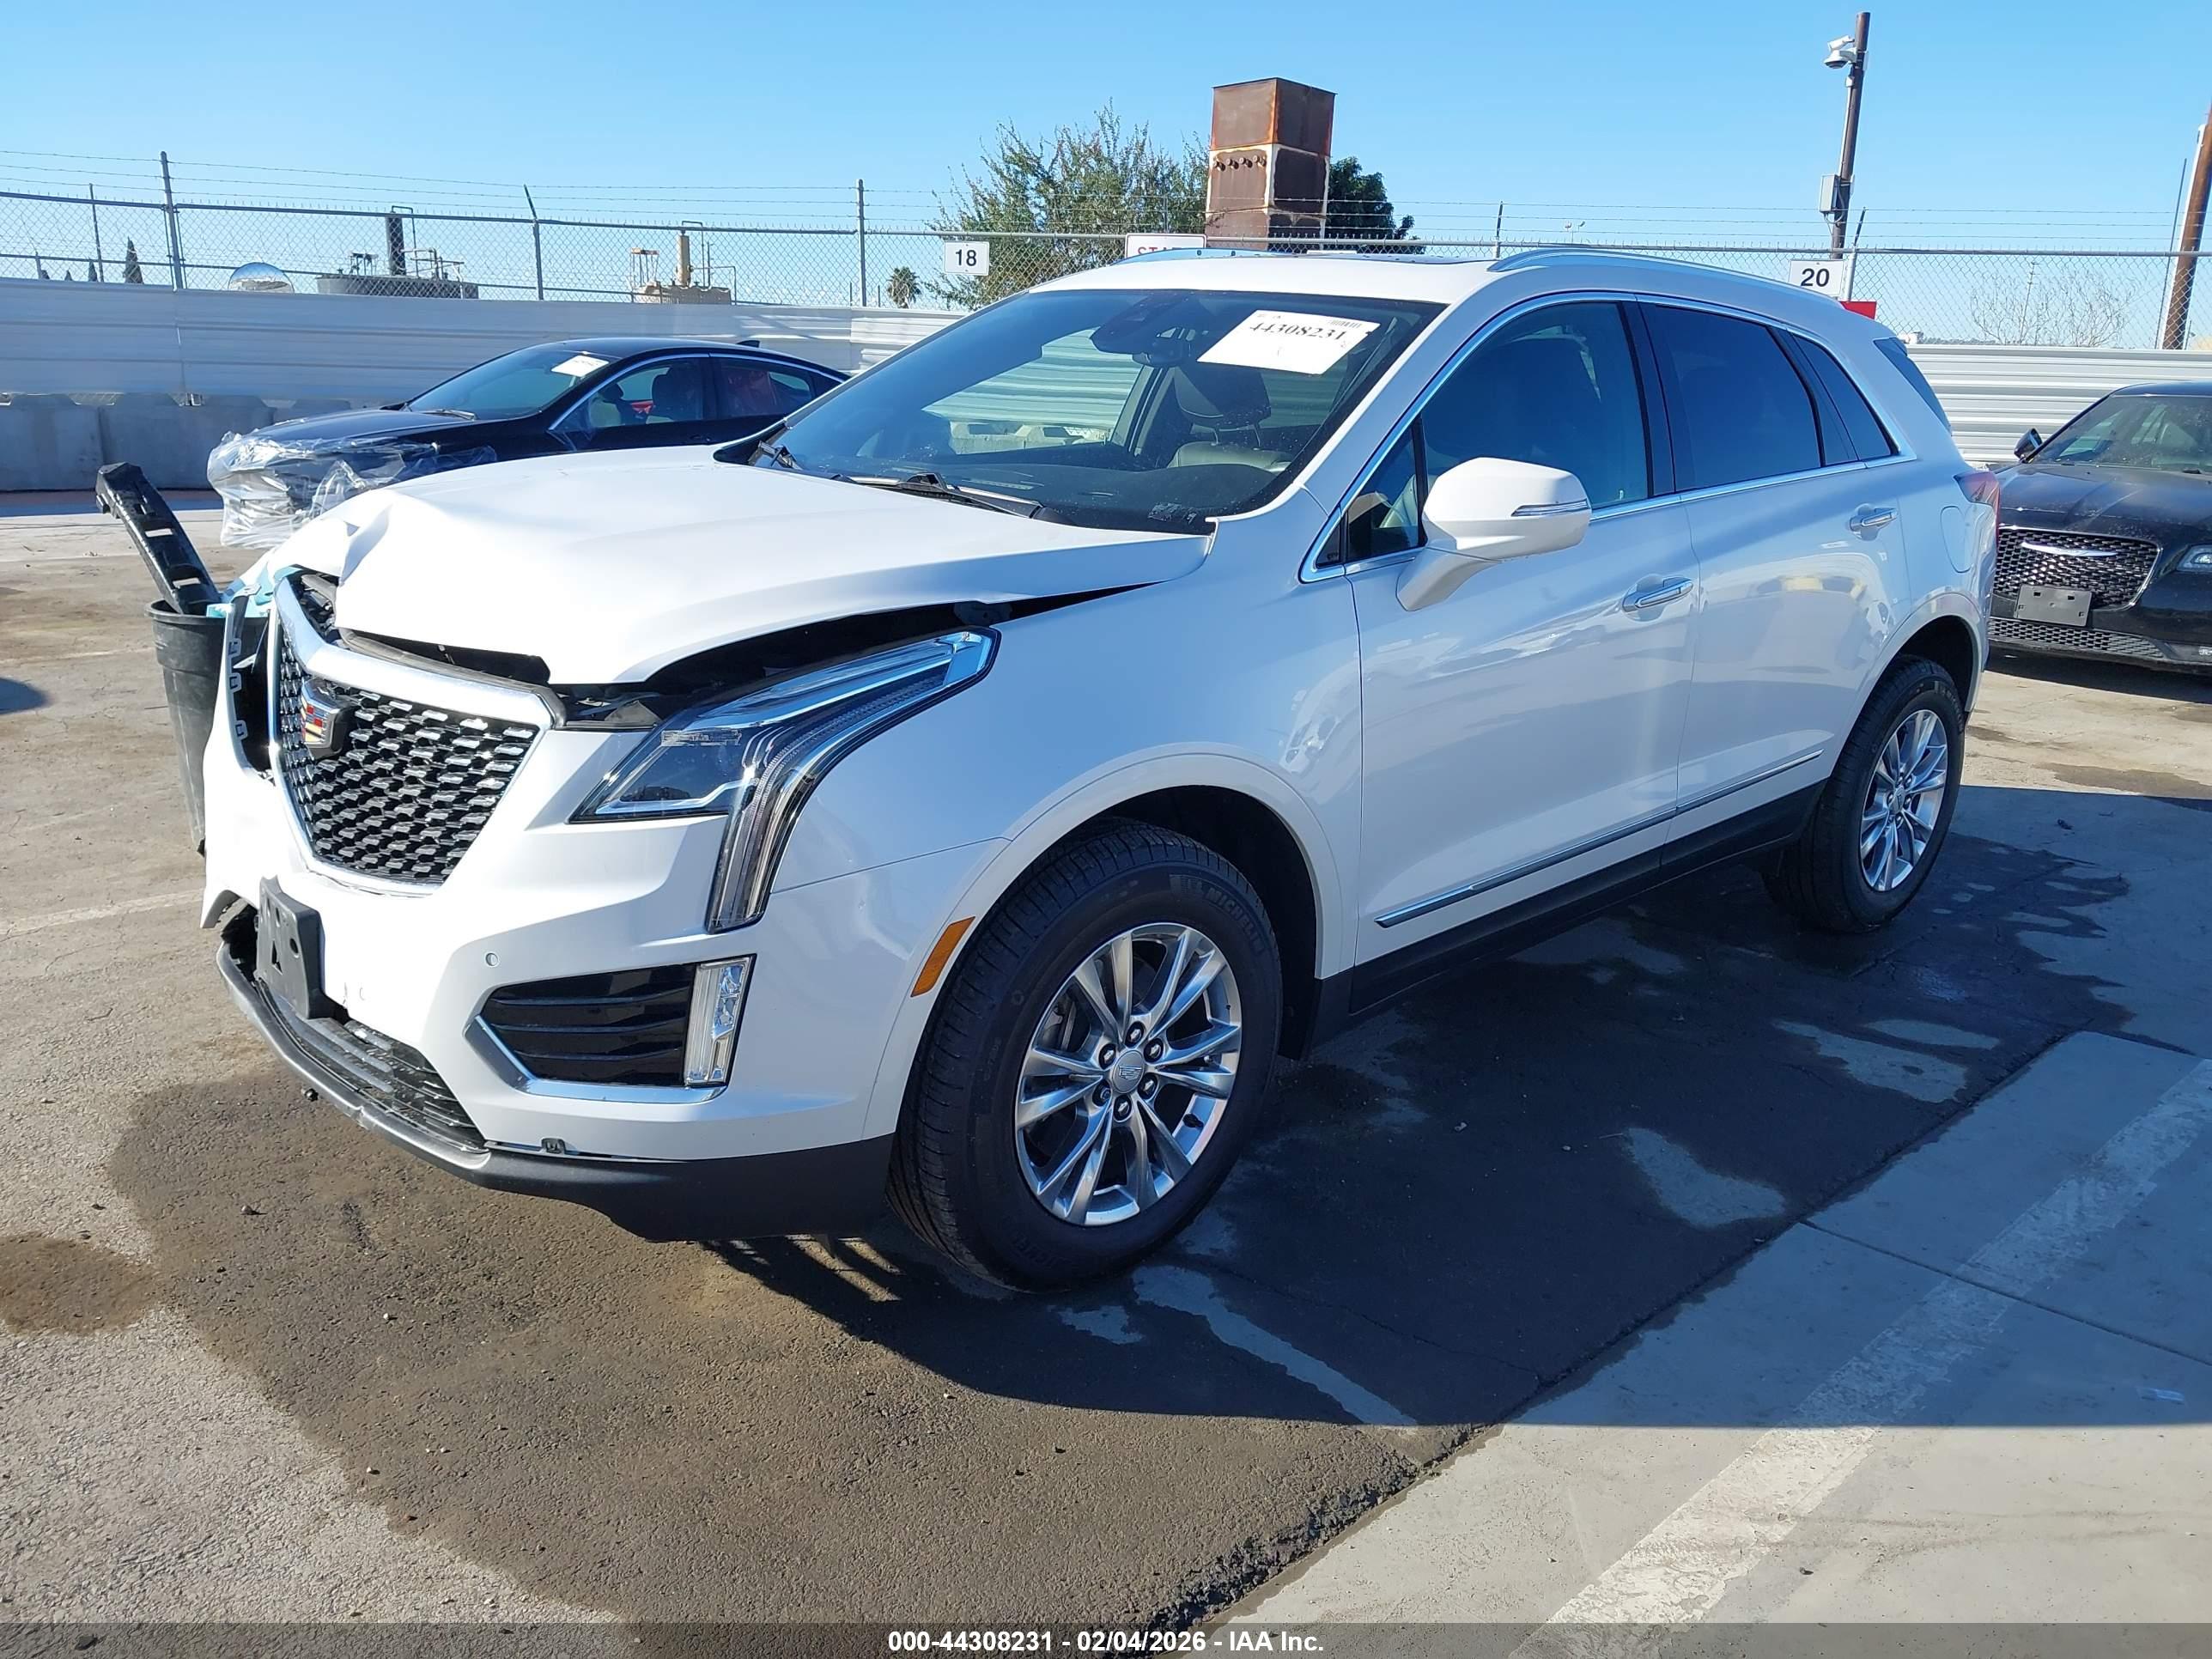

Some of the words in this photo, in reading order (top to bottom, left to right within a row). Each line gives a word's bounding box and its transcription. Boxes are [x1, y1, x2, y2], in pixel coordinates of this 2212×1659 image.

[955, 249, 977, 267] 18
[1800, 268, 1831, 287] 20
[1249, 322, 1347, 340] 44308231
